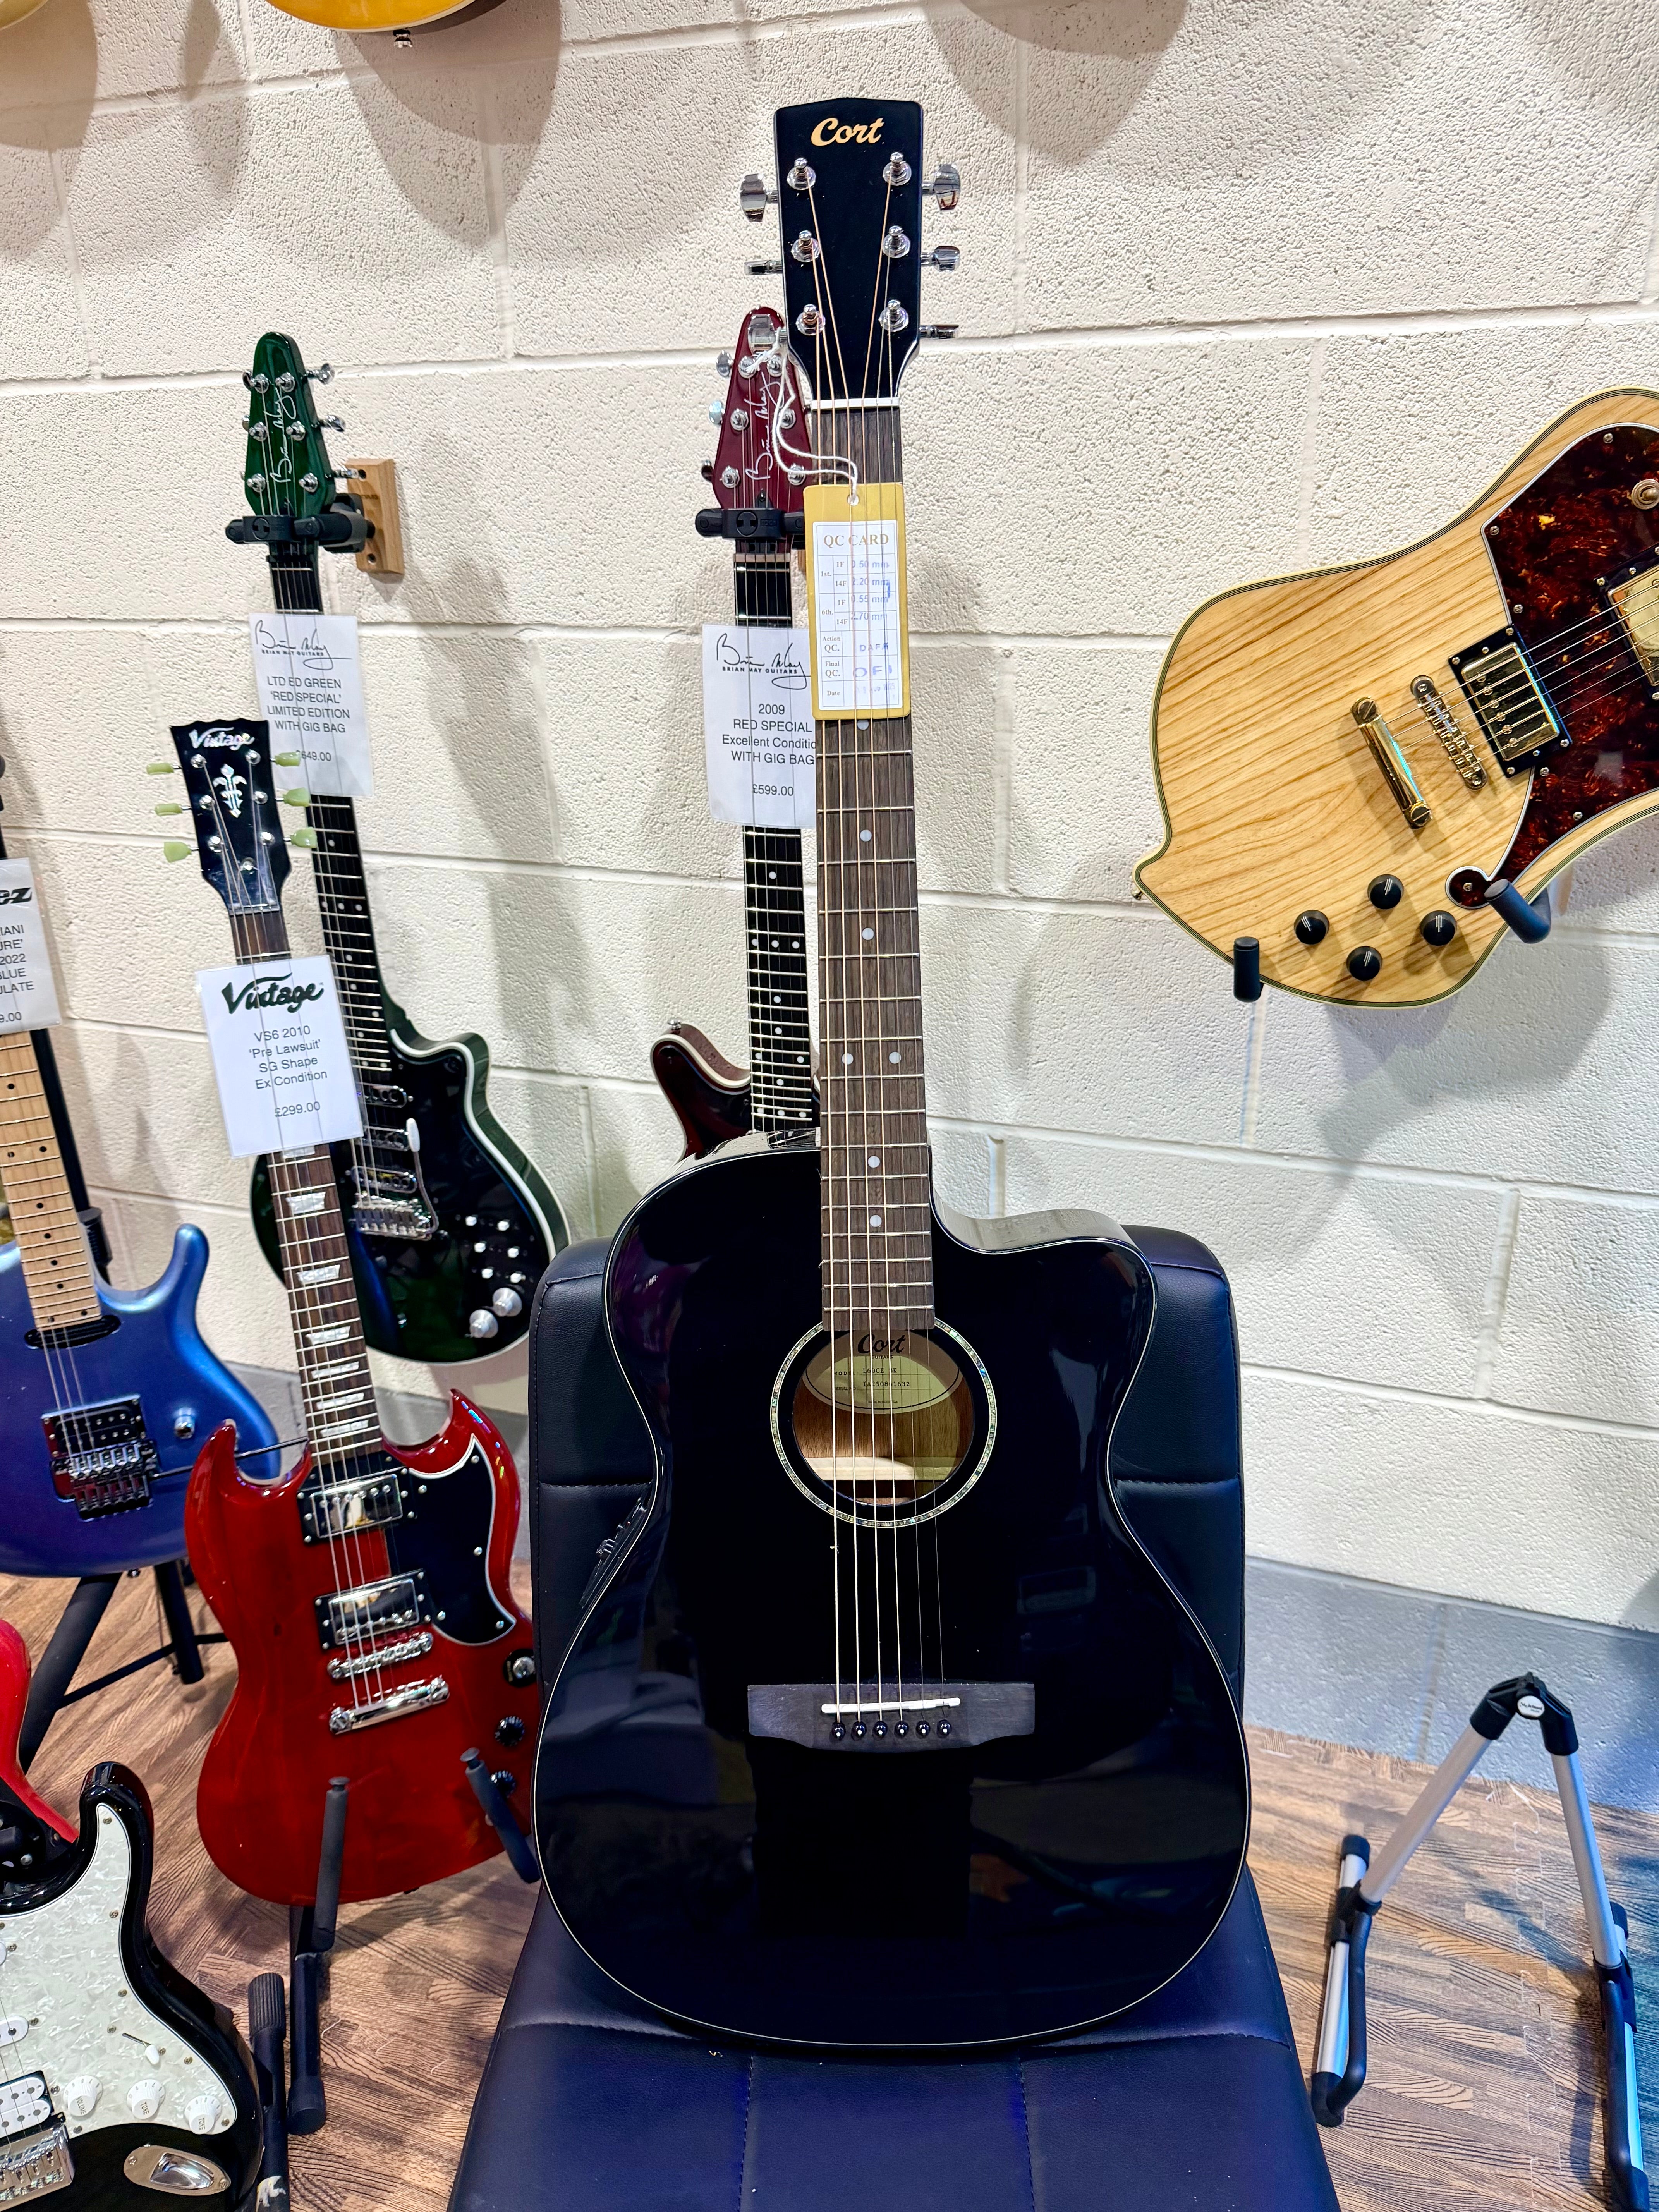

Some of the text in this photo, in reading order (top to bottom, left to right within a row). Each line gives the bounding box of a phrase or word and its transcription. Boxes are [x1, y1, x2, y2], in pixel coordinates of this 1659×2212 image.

[811, 118, 884, 146] Cort
[824, 534, 889, 548] QC CARD
[824, 644, 840, 653] QC.
[825, 670, 841, 678] QC.
[267, 676, 341, 689] LTD ED GREEN
[267, 706, 350, 719] LIMITED EDITION
[758, 704, 785, 715] 2009
[274, 720, 346, 733] WITH GIG BAG
[733, 719, 812, 733] RED SPECIAL
[722, 734, 770, 747] Excellent
[731, 750, 814, 765] WITH GIG BAG
[752, 784, 794, 796] £599.00
[221, 972, 325, 1014] Vintage
[254, 1025, 311, 1042] VS6 2010
[259, 1056, 318, 1073] SG Shape
[255, 1070, 328, 1089] Ex Condition
[275, 1101, 321, 1118] £299.00
[857, 1333, 906, 1354] Cort
[140, 2102, 150, 2116] TONE
